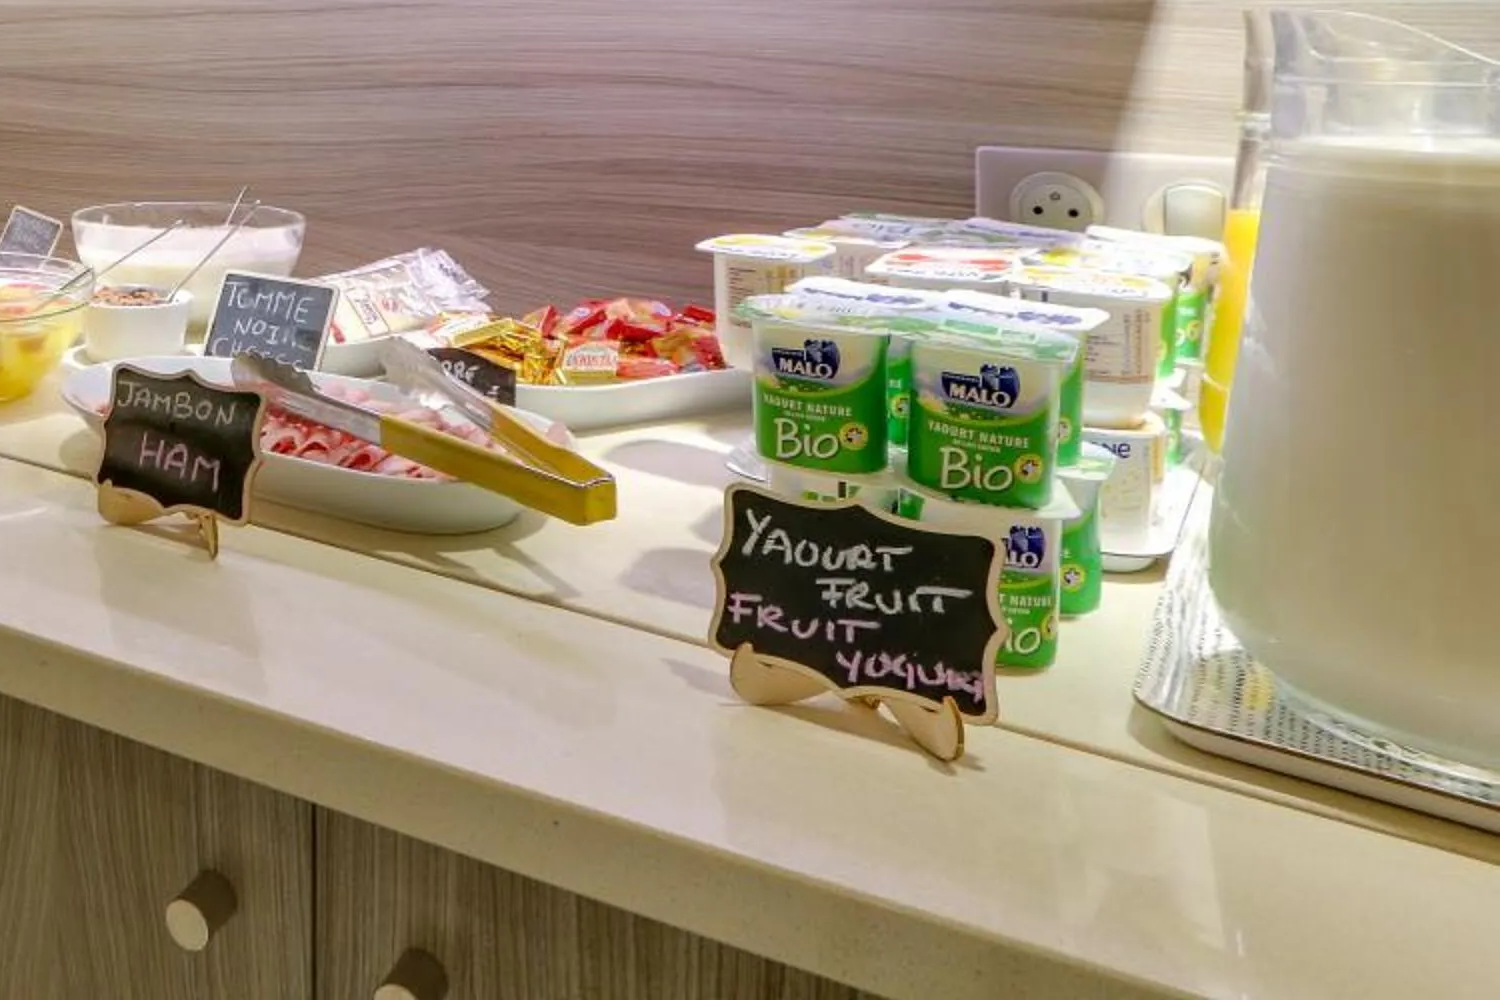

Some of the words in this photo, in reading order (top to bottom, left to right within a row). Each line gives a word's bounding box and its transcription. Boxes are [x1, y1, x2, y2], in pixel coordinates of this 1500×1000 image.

[779, 357, 833, 379] MALO
[117, 380, 236, 426] JAMBON
[807, 403, 852, 417] NATURE
[948, 382, 1011, 407] MALO
[774, 418, 839, 459] Bio
[928, 420, 975, 439] YAOURT
[979, 431, 1029, 449] NATURE
[139, 431, 220, 493] HAM
[939, 446, 1013, 491] Bio
[741, 509, 913, 572] YAOURT
[816, 577, 973, 615] FRUIT
[727, 591, 881, 643] FRUIT
